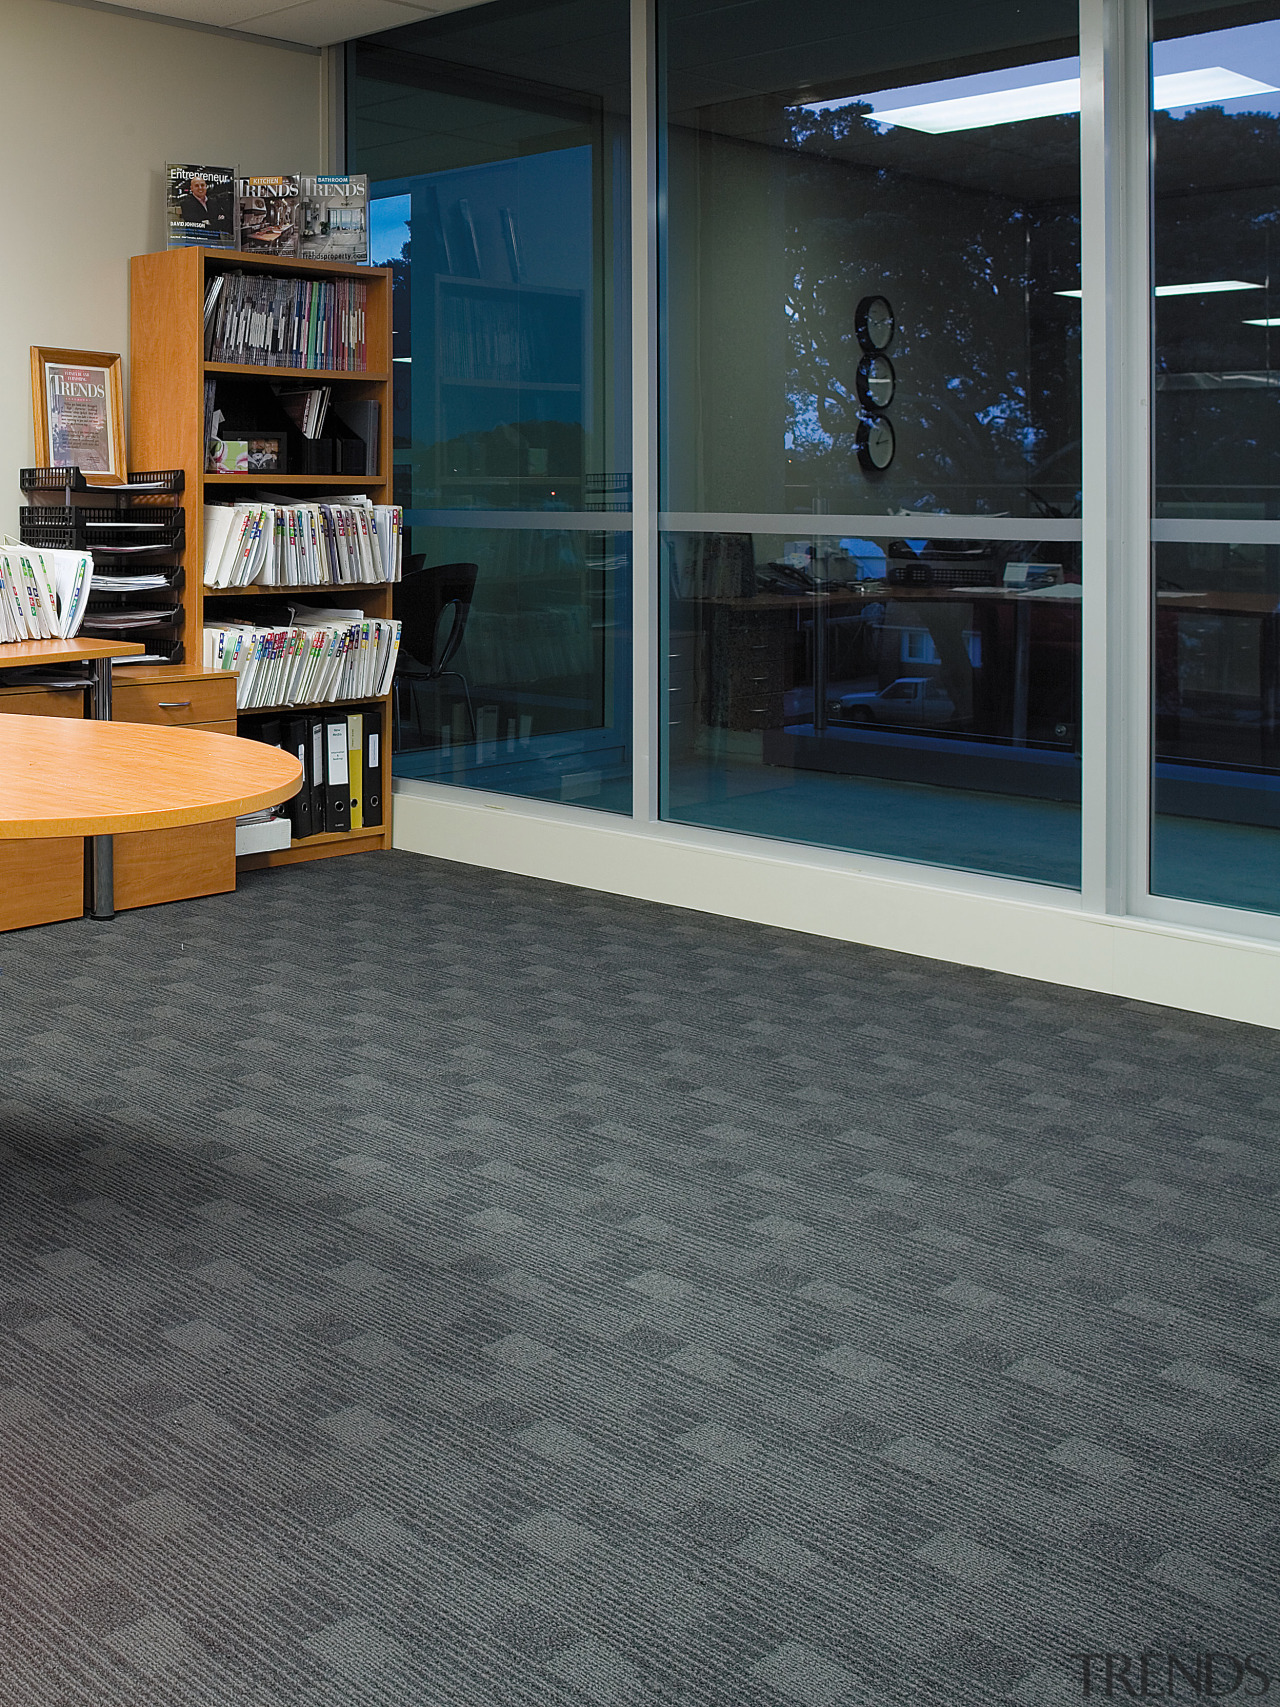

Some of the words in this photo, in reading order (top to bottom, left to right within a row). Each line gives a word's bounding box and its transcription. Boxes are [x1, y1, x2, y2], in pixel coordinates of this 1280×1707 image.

[170, 168, 228, 182] Entrepreneur
[240, 179, 299, 198] TRENDS
[300, 177, 365, 197] TRENDS
[50, 375, 104, 398] TRENDS
